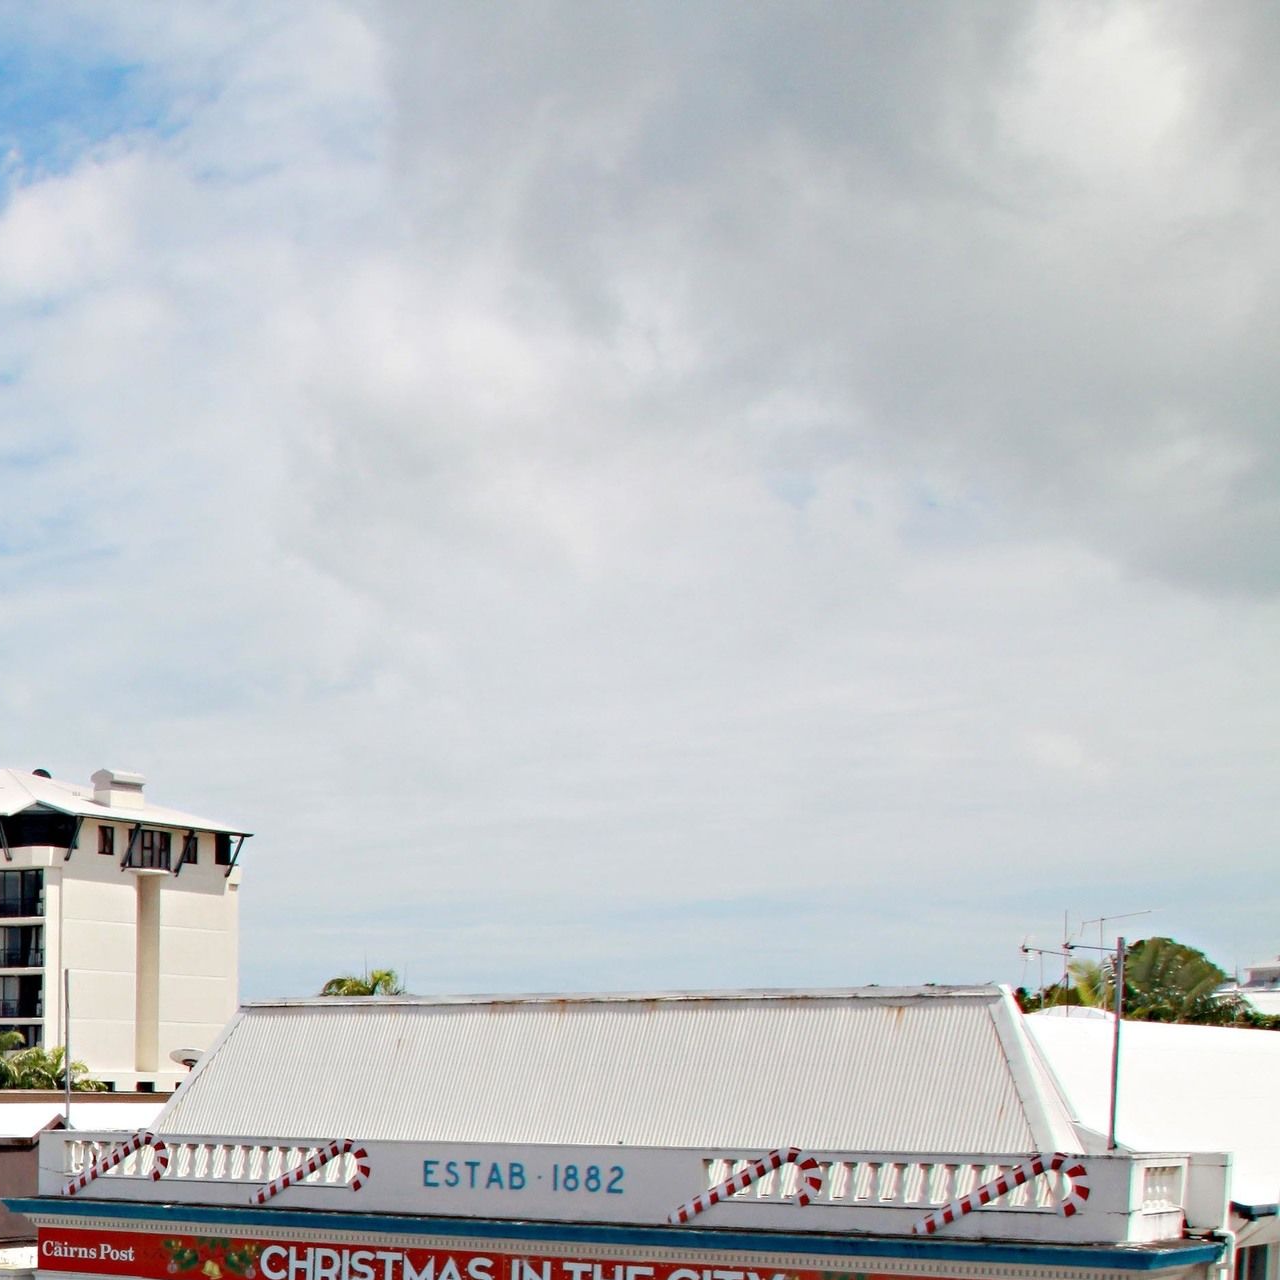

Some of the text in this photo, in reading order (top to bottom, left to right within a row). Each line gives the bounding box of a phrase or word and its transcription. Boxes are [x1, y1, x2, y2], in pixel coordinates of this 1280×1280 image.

[552, 1163, 624, 1194] 1882
[42, 1240, 135, 1261] Cairns Post
